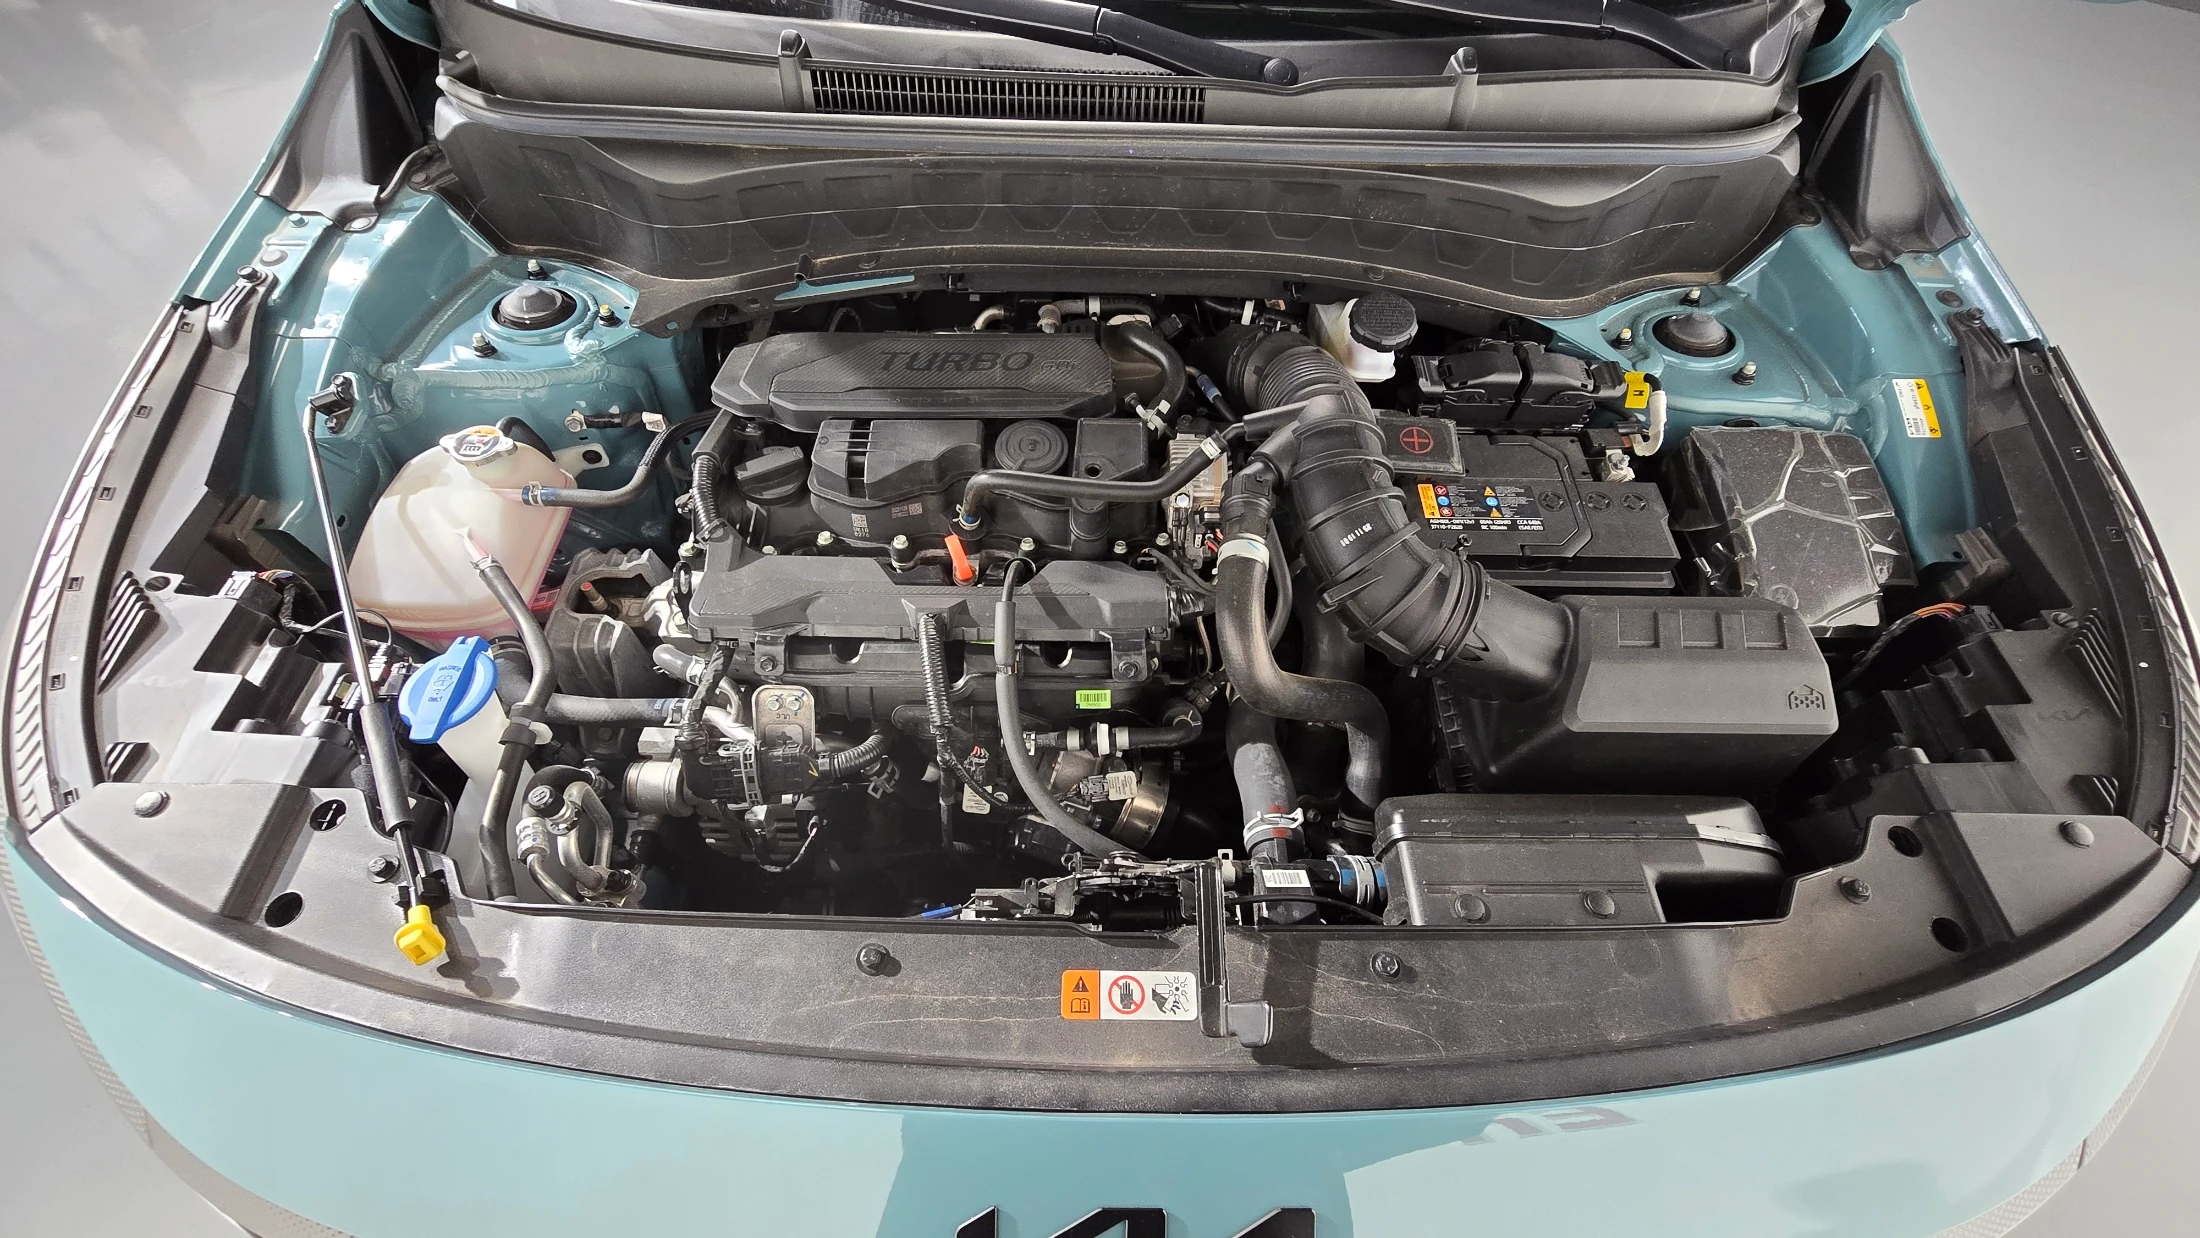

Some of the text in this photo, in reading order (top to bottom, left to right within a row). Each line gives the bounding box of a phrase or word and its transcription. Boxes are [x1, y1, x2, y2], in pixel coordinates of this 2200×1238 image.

[880, 351, 1036, 372] TURBO
[438, 664, 462, 673] WASHER
[427, 695, 444, 703] ONLY
